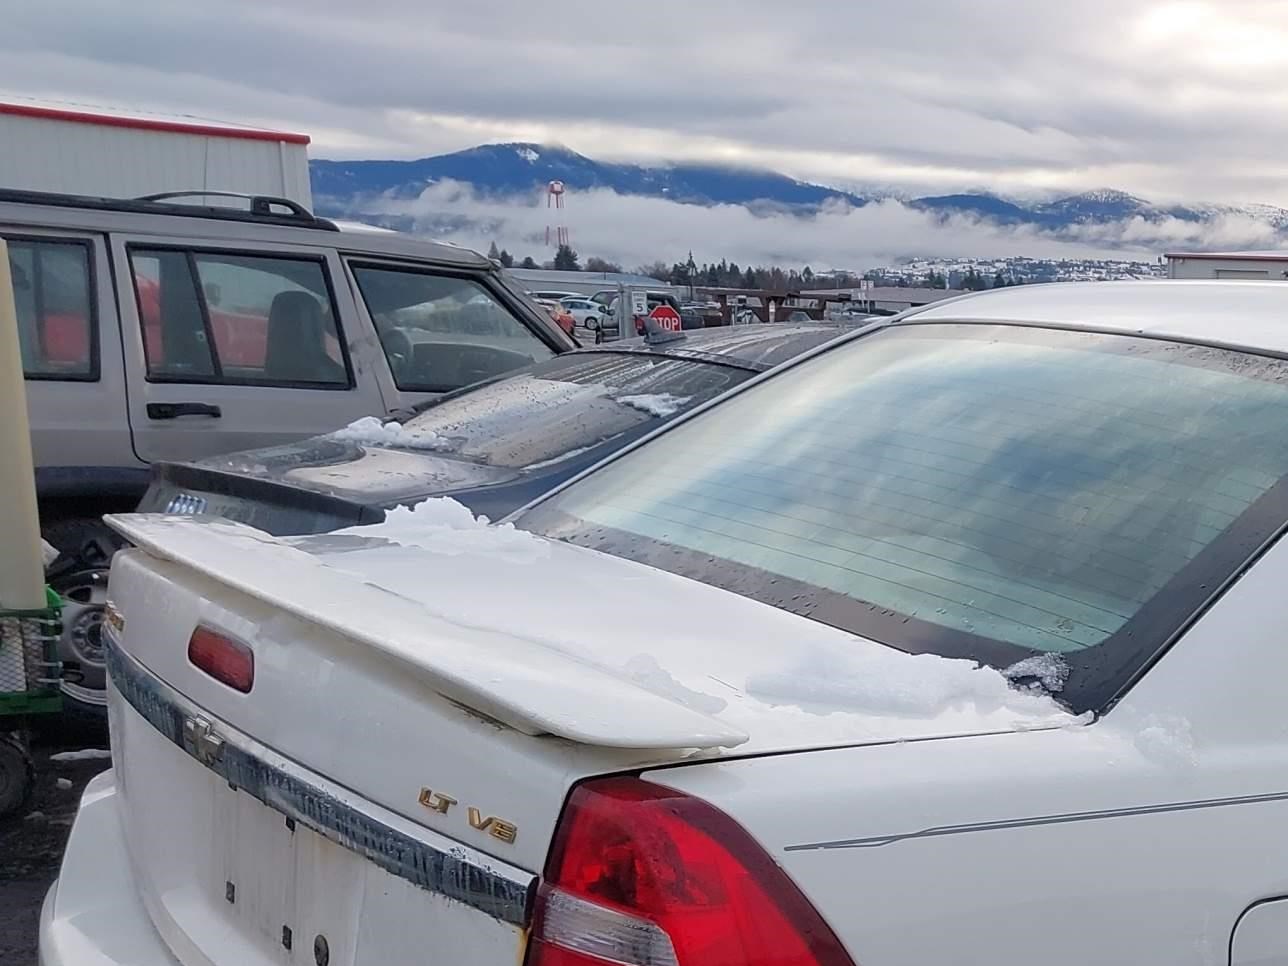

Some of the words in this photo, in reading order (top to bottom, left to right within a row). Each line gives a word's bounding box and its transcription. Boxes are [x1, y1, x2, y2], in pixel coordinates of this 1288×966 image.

[636, 303, 643, 312] 5
[653, 317, 678, 331] TOP
[418, 786, 458, 814] LT
